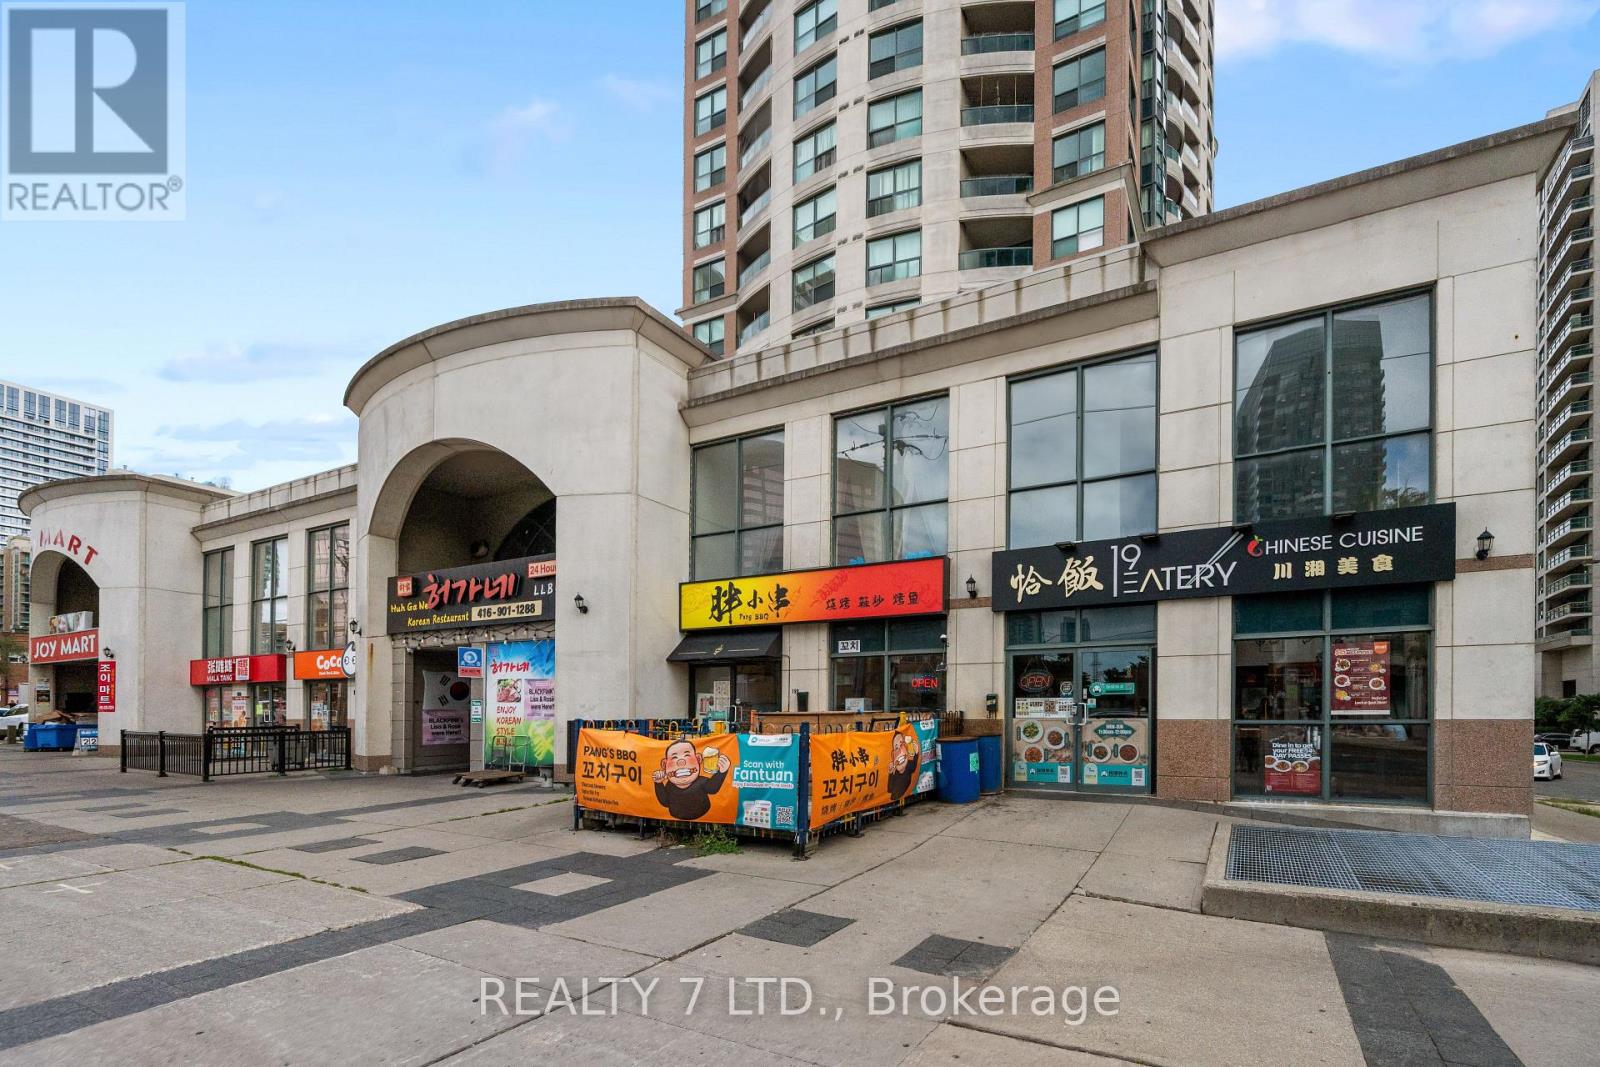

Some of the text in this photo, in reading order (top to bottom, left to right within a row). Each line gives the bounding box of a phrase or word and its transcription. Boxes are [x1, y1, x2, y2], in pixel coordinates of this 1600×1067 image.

[1339, 526, 1424, 549] CUISINE
[529, 566, 539, 575] 24
[1110, 543, 1142, 598] 19
[1273, 554, 1394, 580] 川湘美食
[1010, 555, 1104, 603] 恰飯
[1123, 561, 1238, 594] EATERY
[533, 582, 556, 596] LLB
[390, 604, 405, 612] Huh
[407, 602, 417, 611] Ga
[477, 604, 535, 618] 416-901-1288
[407, 611, 469, 627] Korean Restaurant
[34, 634, 96, 658] JOY MART
[840, 641, 859, 650] 꼬치
[98, 664, 111, 704] 조이마트
[911, 677, 938, 688] OPEN
[497, 706, 516, 714] ENJOY
[496, 717, 522, 725] KOREAN
[584, 746, 637, 763] PANG'S BBQ
[743, 760, 764, 768] Scan
[582, 761, 642, 785] 꼬치구이
[733, 767, 794, 782] Fantuan
[822, 770, 879, 799] 꼬치구이
